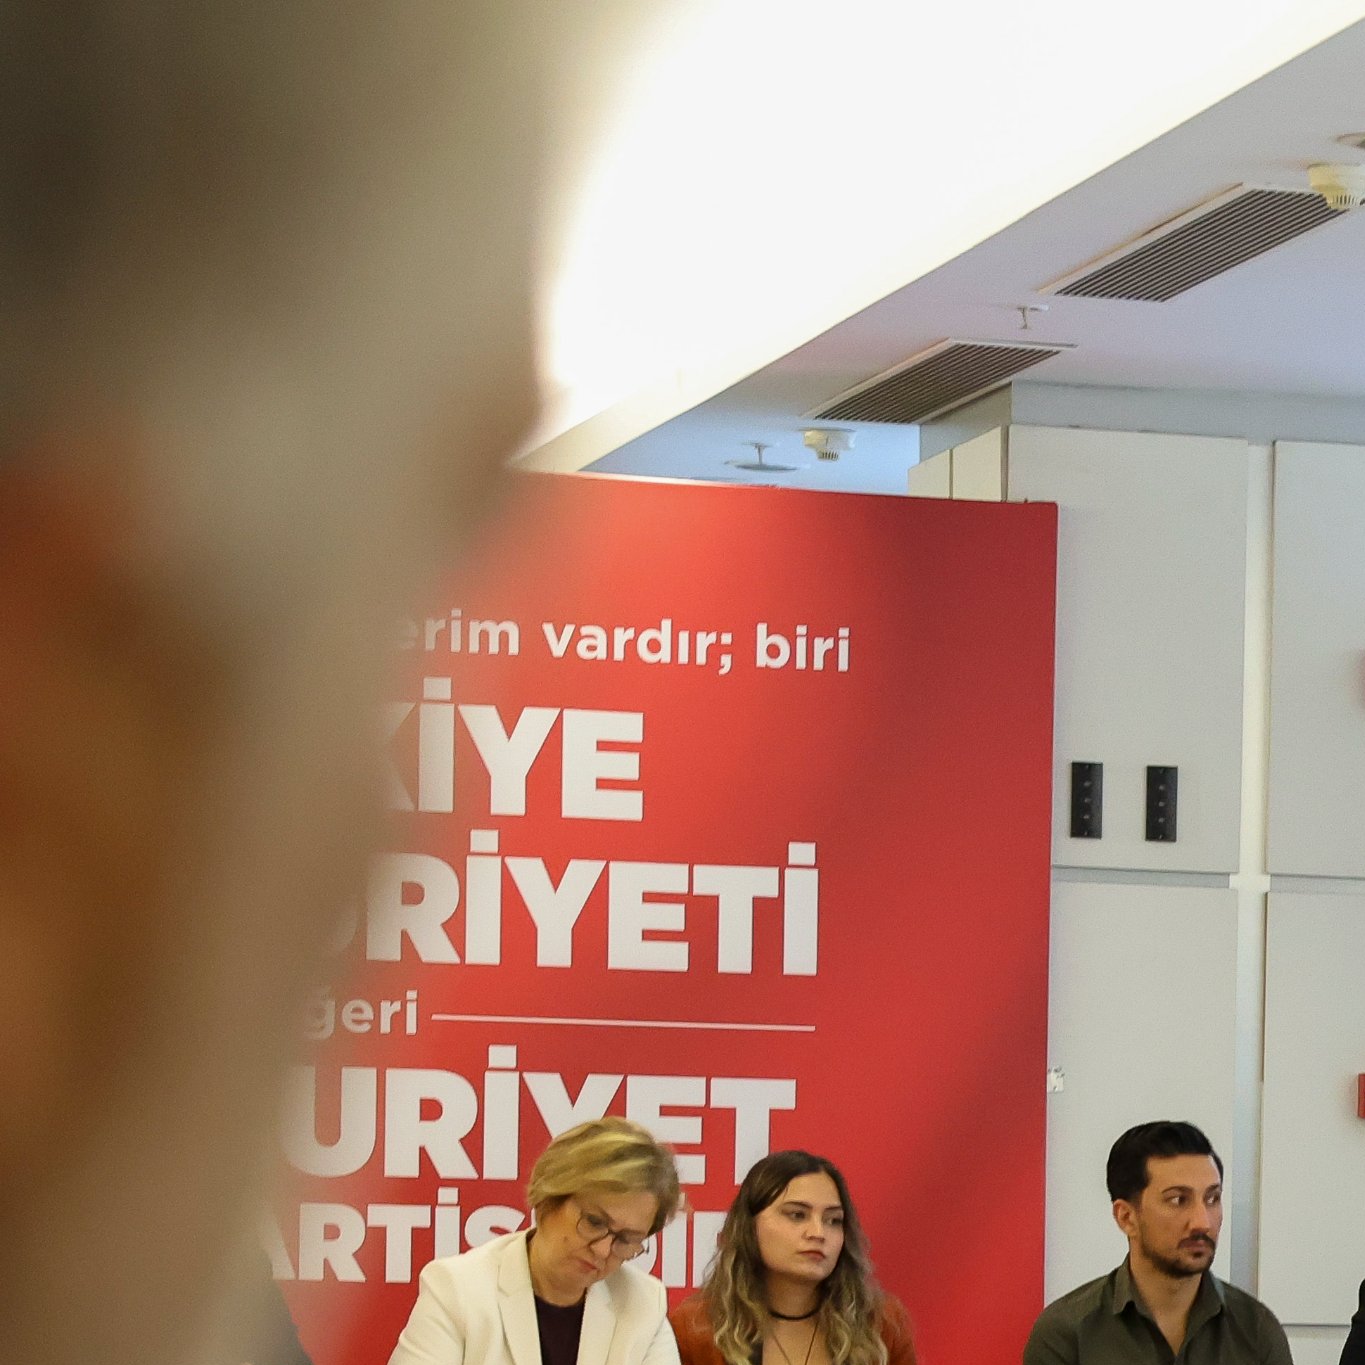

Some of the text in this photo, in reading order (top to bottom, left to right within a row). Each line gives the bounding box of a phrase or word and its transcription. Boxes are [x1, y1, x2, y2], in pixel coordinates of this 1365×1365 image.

[542, 618, 733, 675] vardır;
[755, 622, 850, 673] biri
[335, 828, 820, 977] RİYETİ
